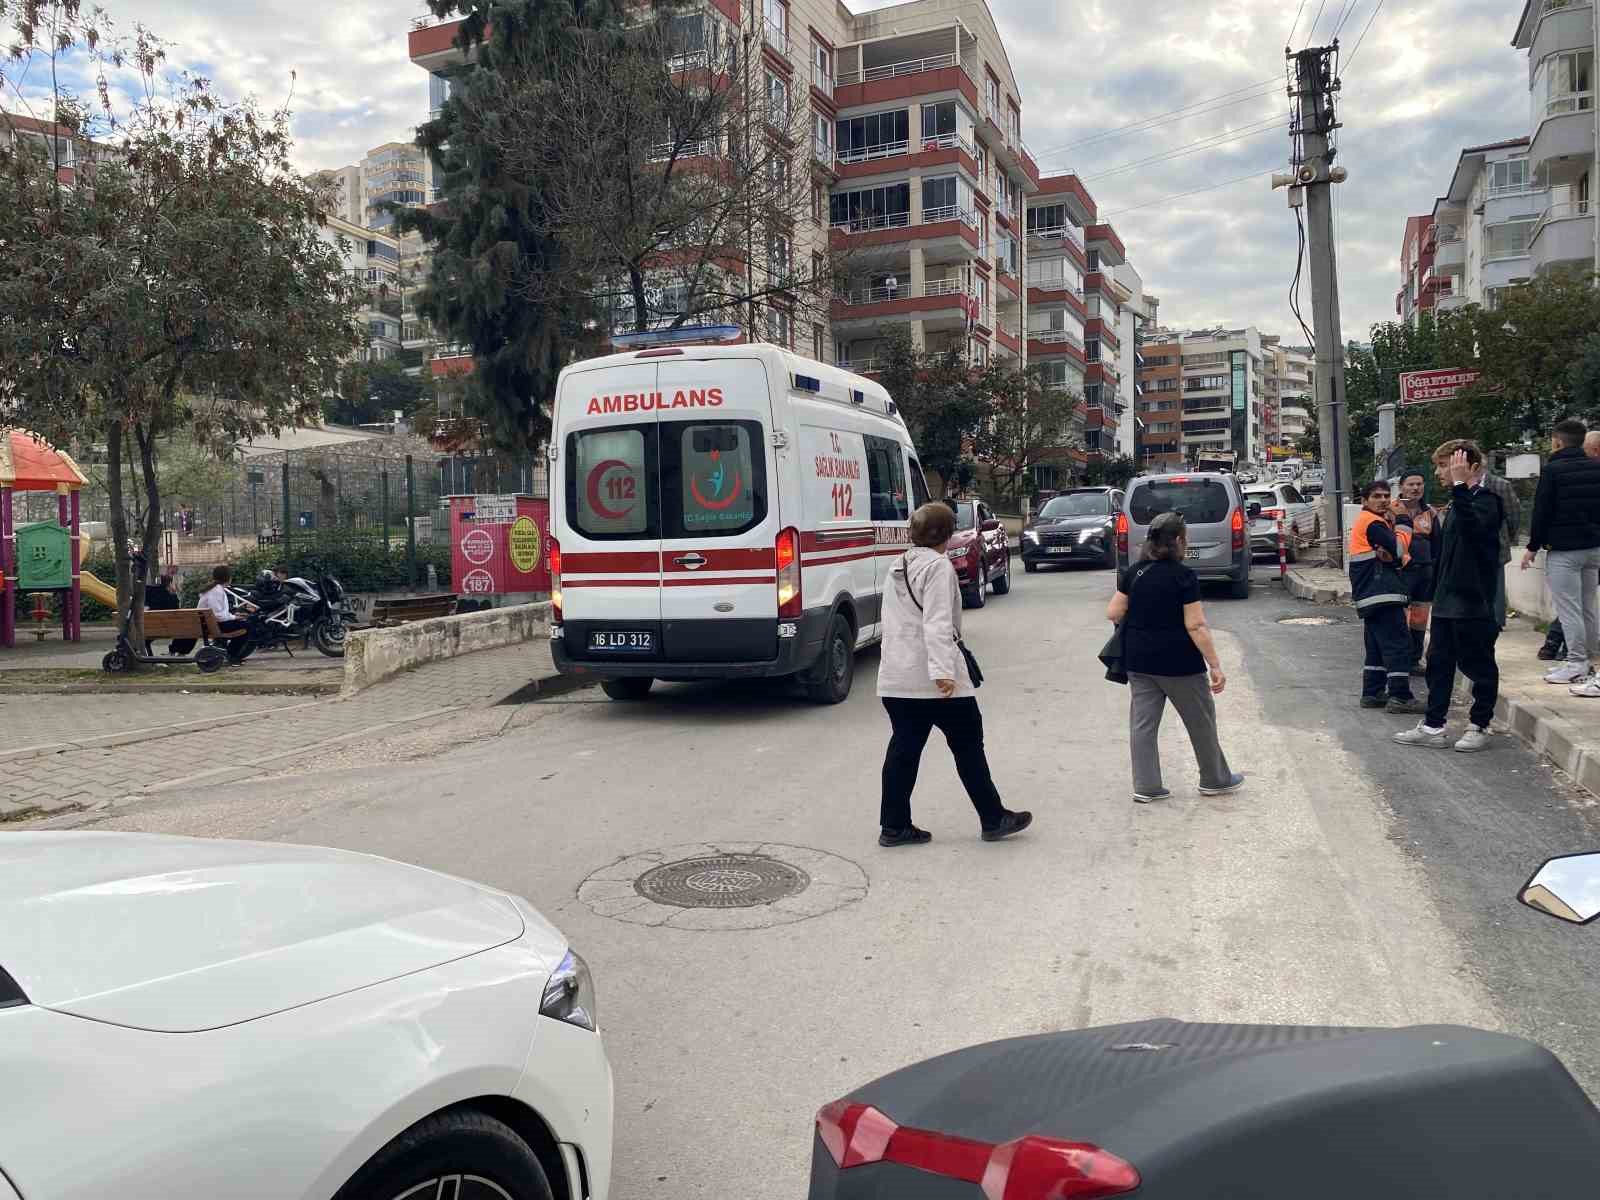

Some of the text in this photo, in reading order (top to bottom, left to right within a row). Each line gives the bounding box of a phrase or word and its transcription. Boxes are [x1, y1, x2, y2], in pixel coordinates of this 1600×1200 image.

[587, 388, 723, 415] AMBULANS
[606, 477, 635, 499] 112
[832, 483, 852, 517] 112
[874, 527, 909, 545] AMBULANS
[469, 579, 490, 592] 187
[595, 633, 650, 646] 16 LD 312
